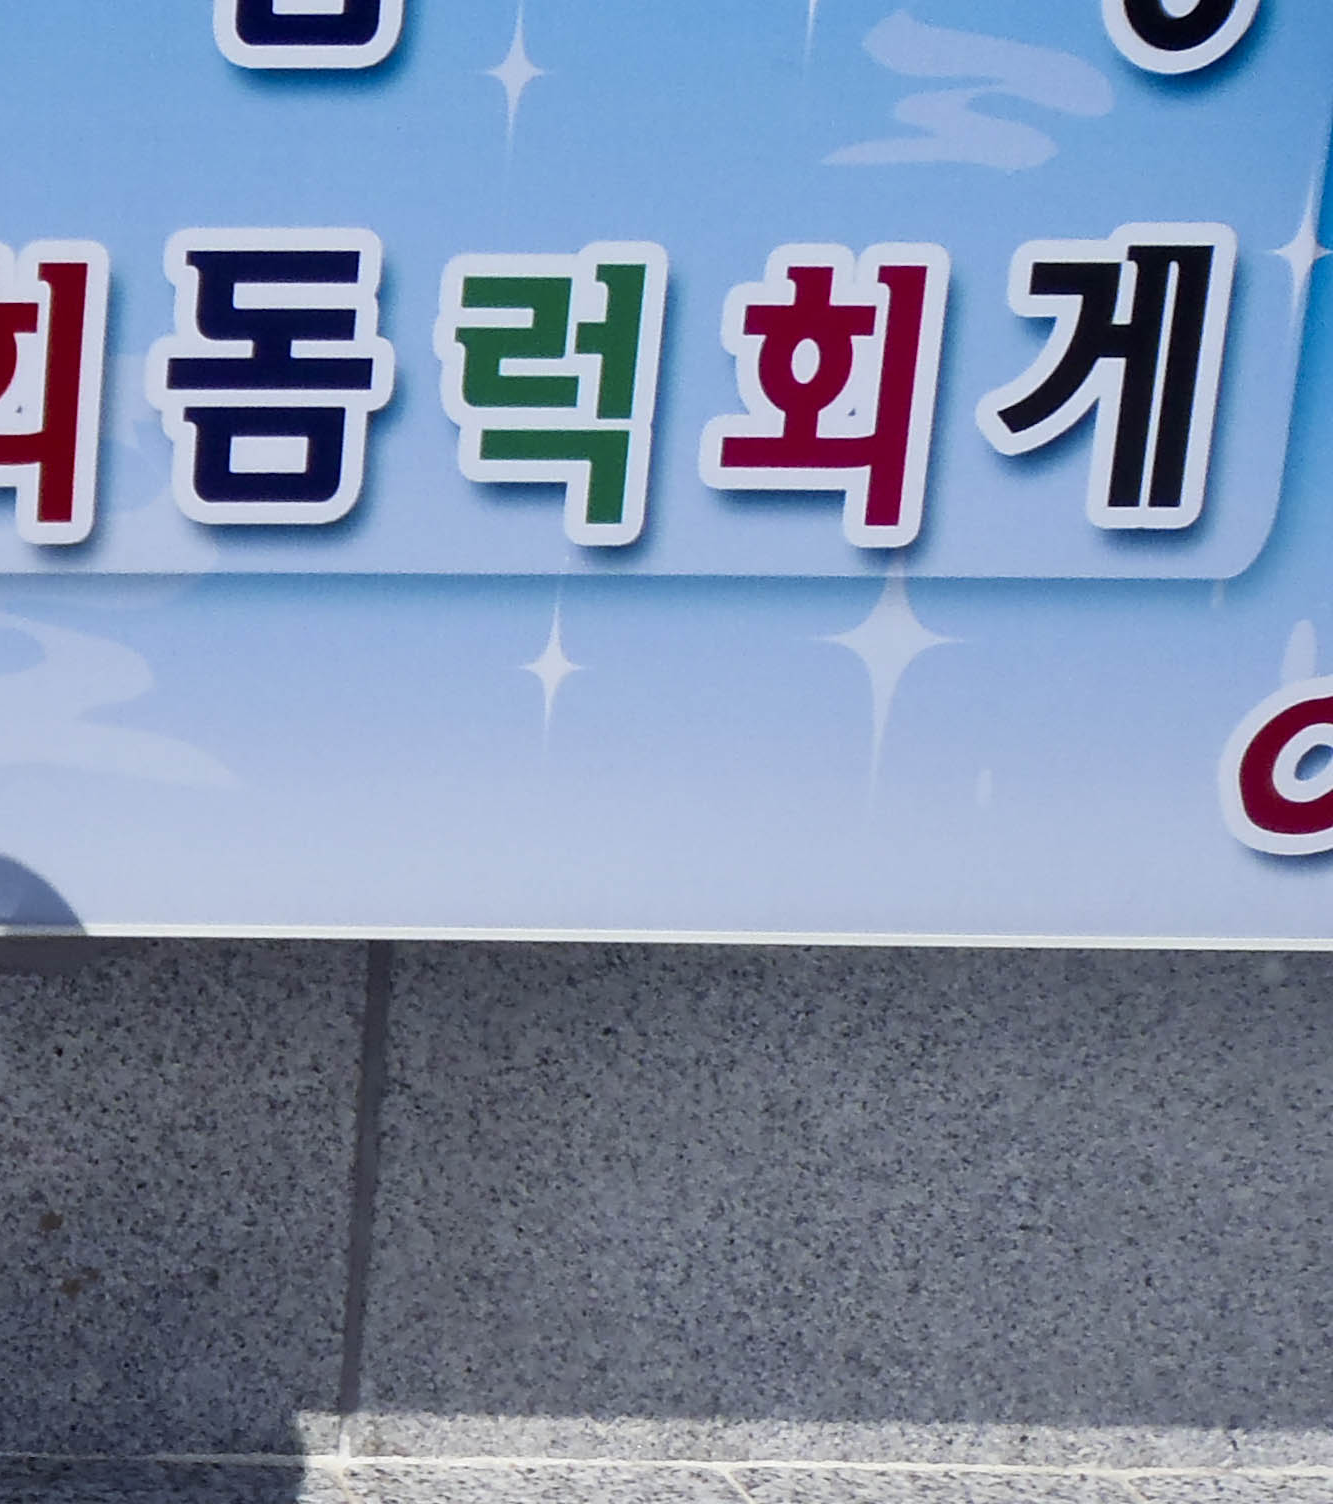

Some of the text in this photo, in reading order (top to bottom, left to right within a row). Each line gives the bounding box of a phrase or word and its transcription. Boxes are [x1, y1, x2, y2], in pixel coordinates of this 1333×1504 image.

[155, 232, 388, 522] 돔
[443, 245, 663, 540] 럭
[708, 248, 943, 542] 회
[985, 228, 1233, 525] 게
